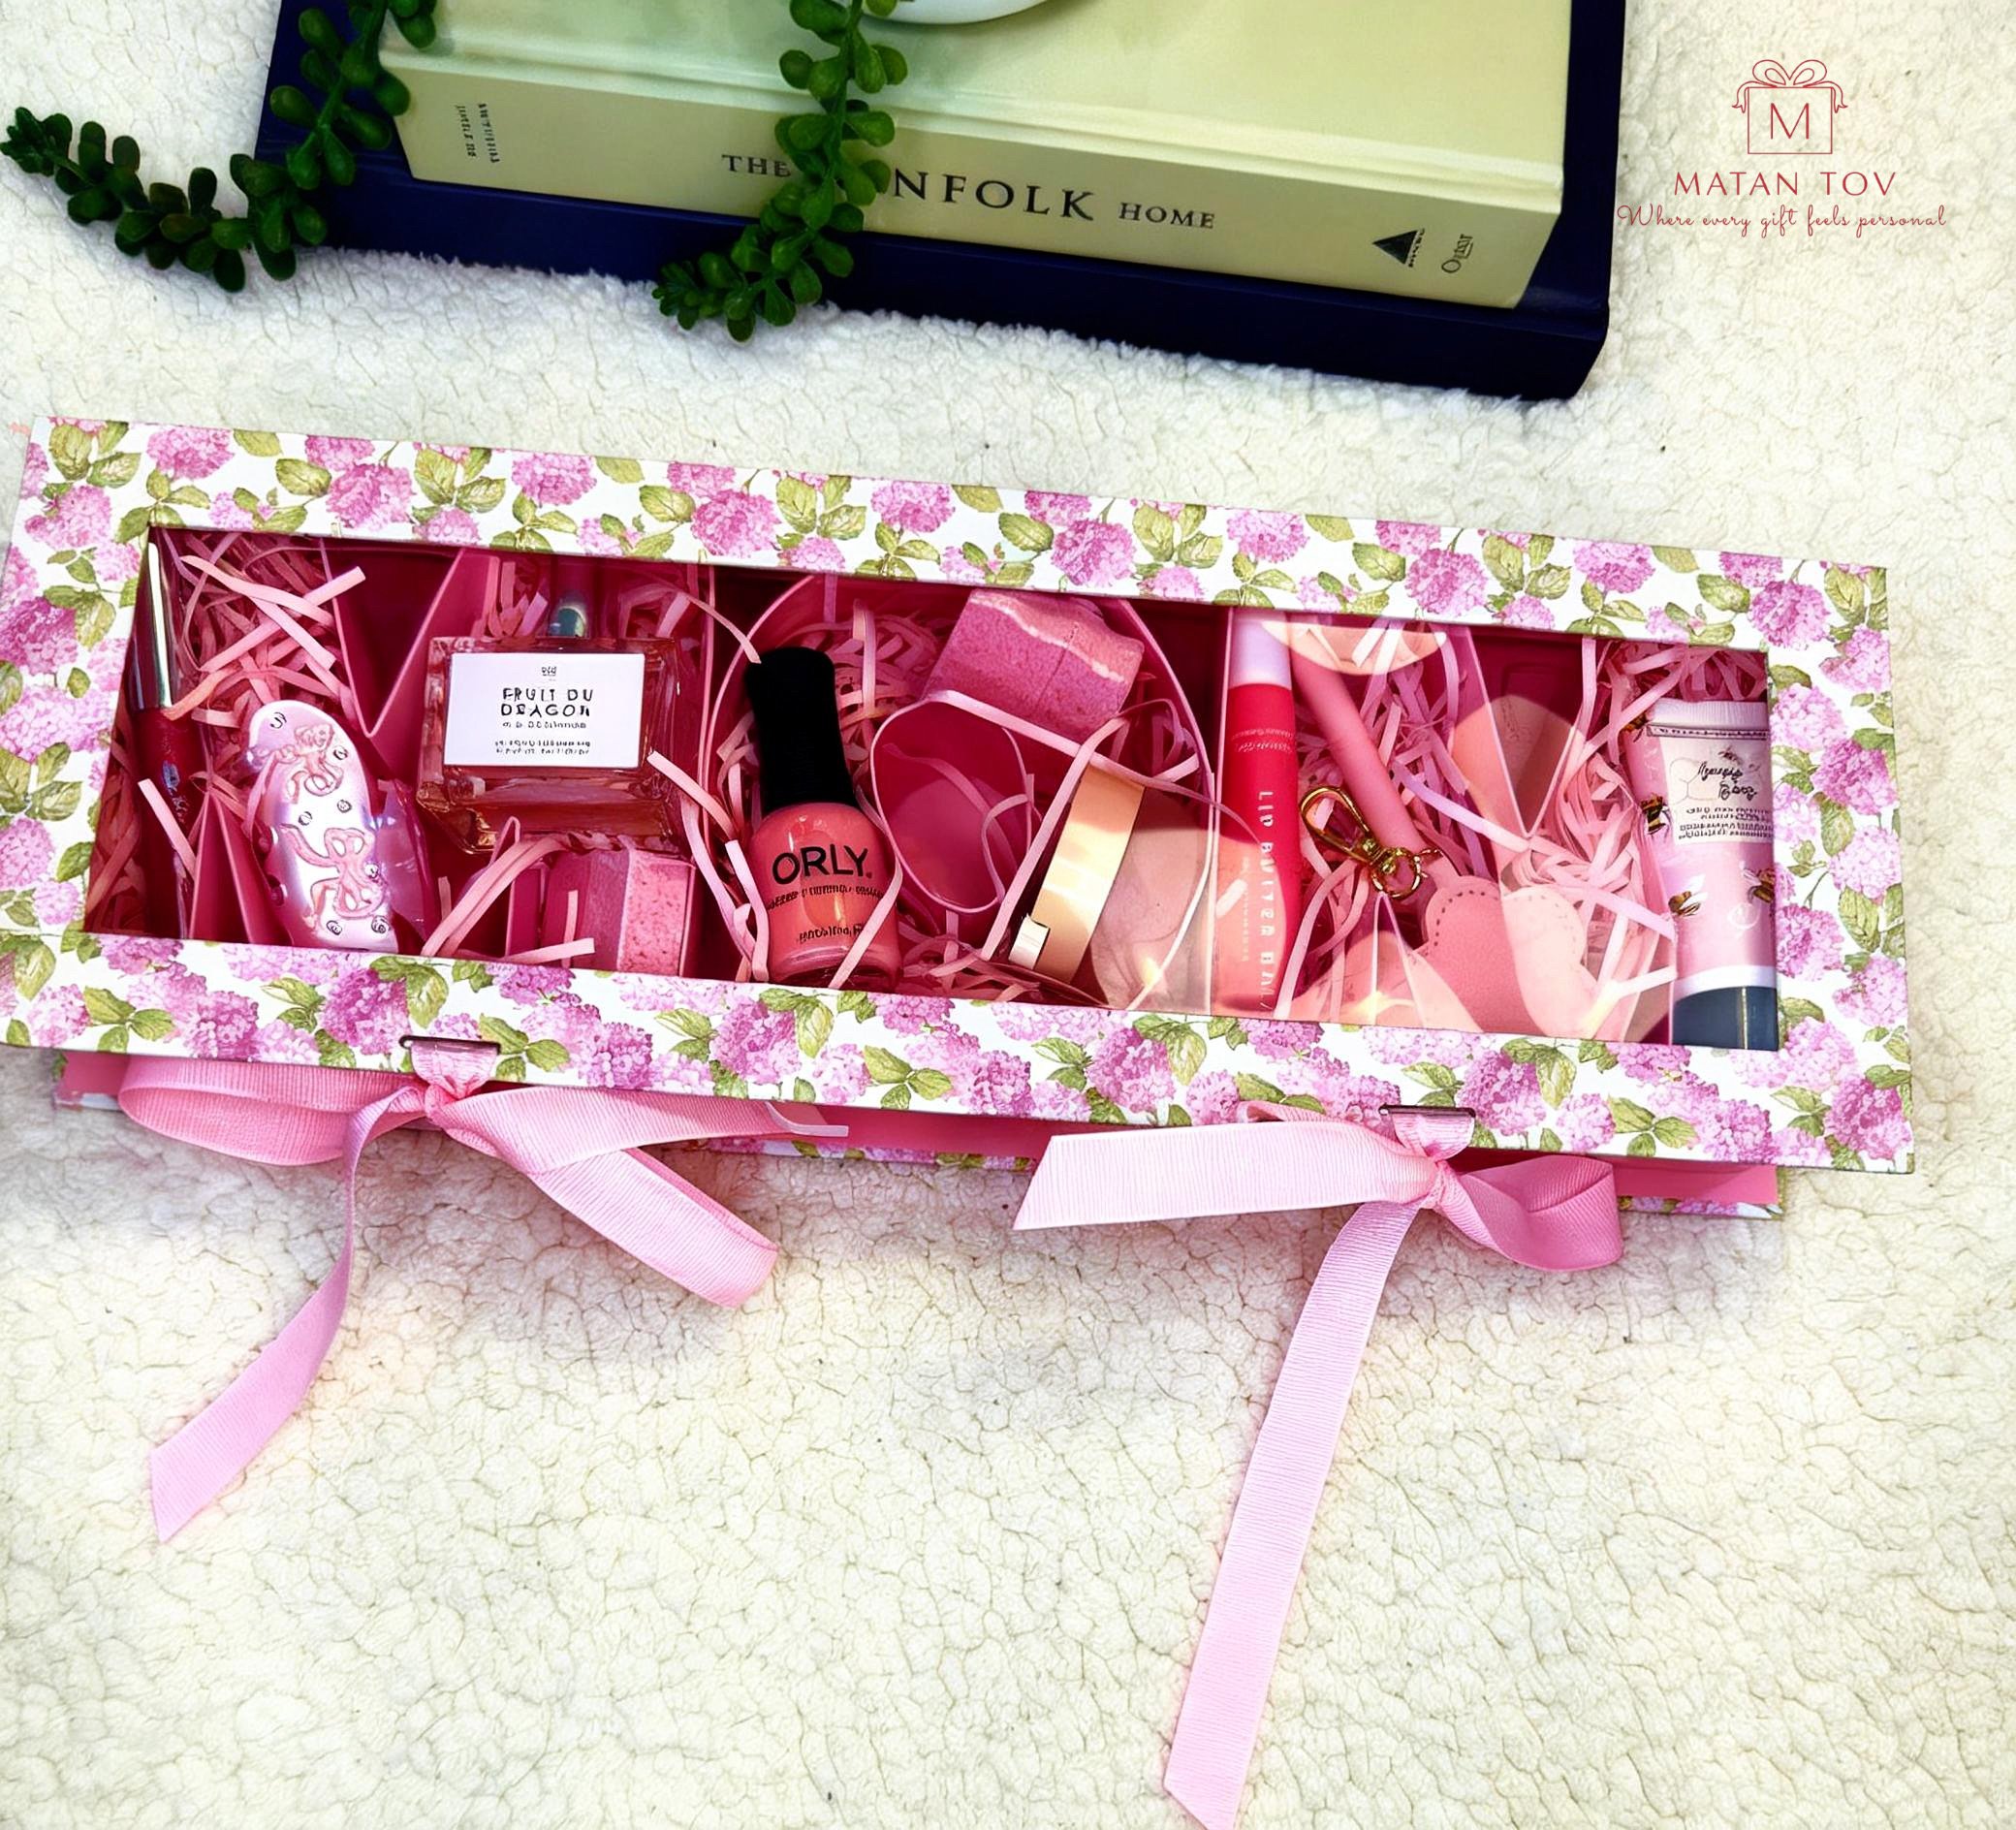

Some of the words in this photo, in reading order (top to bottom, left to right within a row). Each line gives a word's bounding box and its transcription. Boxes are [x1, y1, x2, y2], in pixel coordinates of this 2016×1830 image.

[721, 154, 792, 177] THE
[892, 167, 1095, 222] NFOLK
[1118, 201, 1215, 230] HOME
[567, 688, 593, 702] DU
